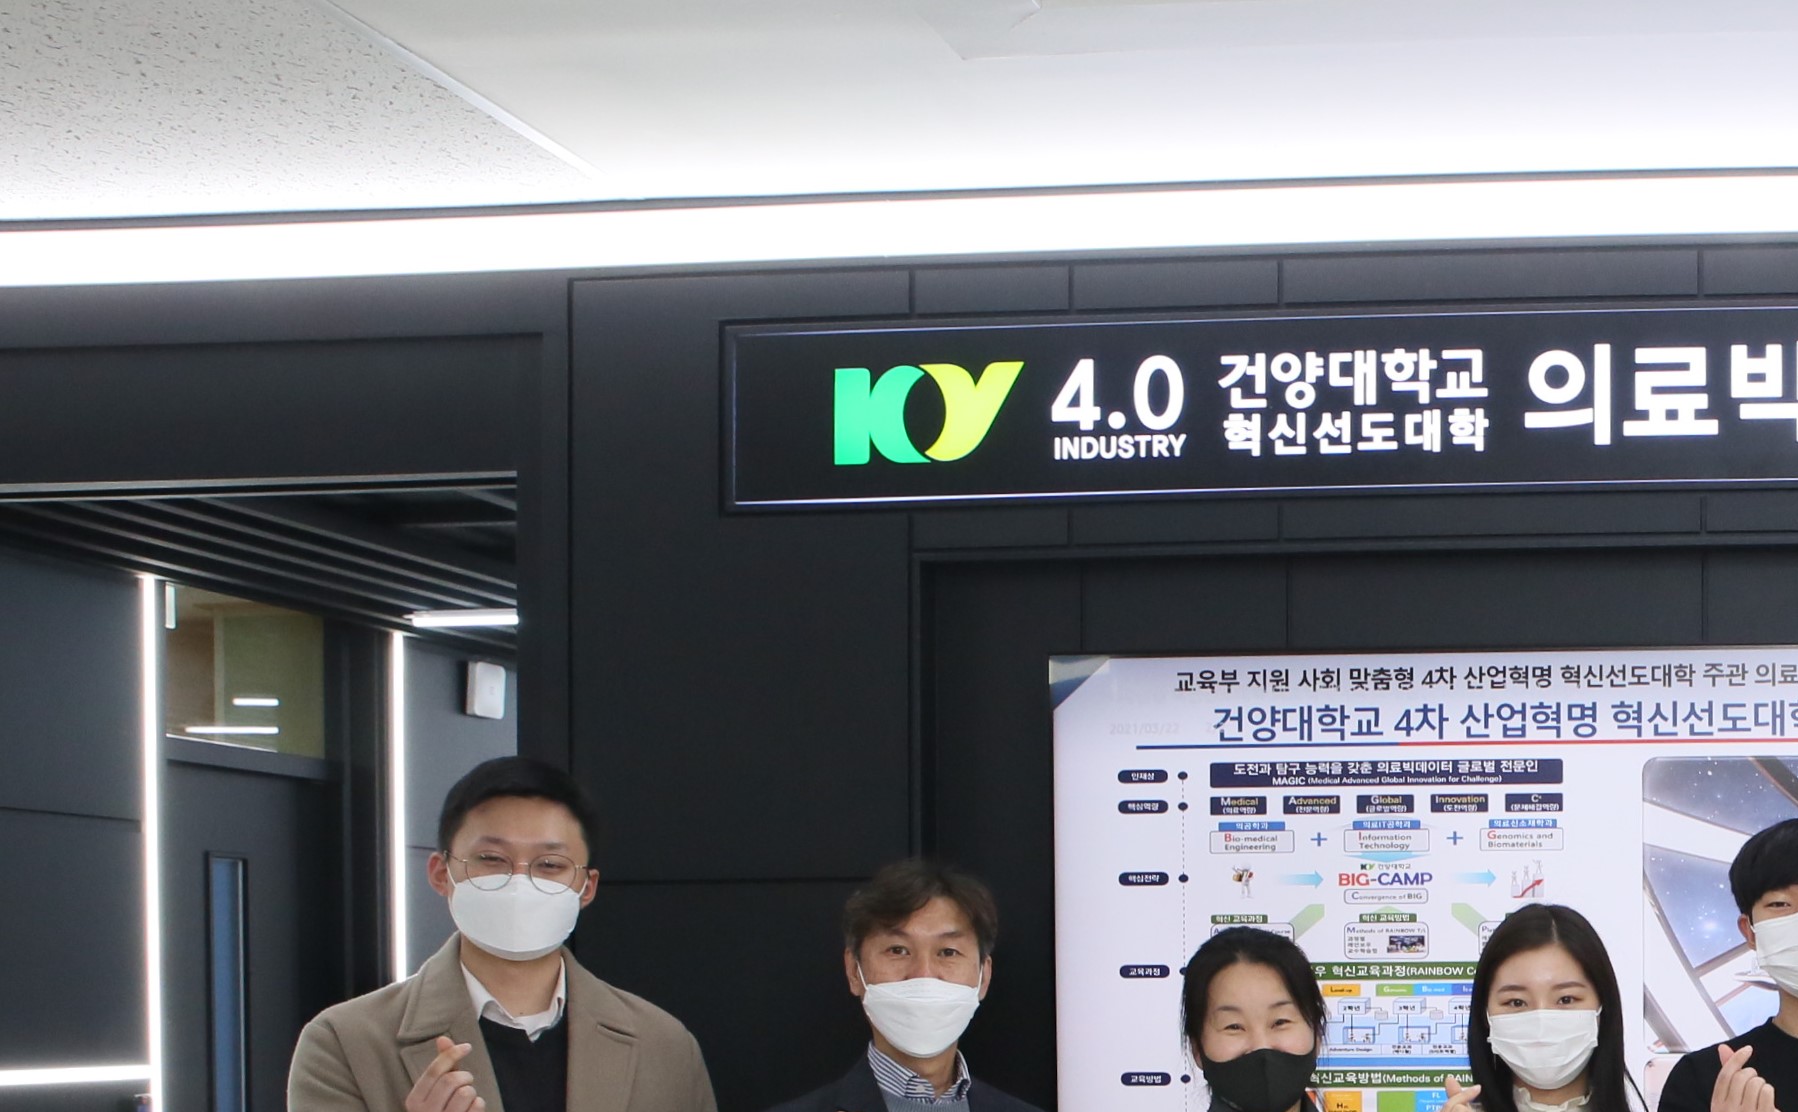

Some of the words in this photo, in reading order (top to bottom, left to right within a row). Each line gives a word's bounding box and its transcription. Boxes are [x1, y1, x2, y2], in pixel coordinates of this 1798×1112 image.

[1217, 346, 1489, 410] 건양대학교
[1050, 355, 1185, 431] 4.0
[1222, 408, 1490, 455] 혁신선도대학
[1053, 432, 1187, 461] INDUSTRY
[1173, 669, 1240, 693] 교육부
[1247, 668, 1290, 693] 지원
[1297, 667, 1341, 693] 사회
[1349, 666, 1415, 691] 맞춤형
[1421, 665, 1457, 690] 4차
[1463, 664, 1552, 690] 산업혁명
[1560, 663, 1696, 688] 혁신선도대학
[1702, 662, 1749, 687] 주관
[1212, 703, 1384, 742] 건양대학교
[1393, 702, 1449, 740] 4차
[1459, 701, 1598, 739] 산업혁명
[1233, 762, 1272, 776] 도전과
[1276, 762, 1301, 775] 탐구
[1305, 762, 1343, 775] 능력을
[1347, 761, 1373, 775] 갖춘
[1377, 760, 1453, 774] 의료빅데이터
[1457, 760, 1496, 773] 글로벌
[1500, 760, 1538, 773] 전문인
[1272, 776, 1306, 786] MAGIC
[1307, 776, 1340, 786] (Medical
[1341, 776, 1380, 785] Advanced
[1381, 775, 1405, 784] Global
[1407, 775, 1447, 783] Innovation
[1448, 775, 1460, 783] for
[1220, 797, 1259, 806] Medical
[1288, 796, 1337, 805] Advanced
[1370, 794, 1403, 804] Global
[1435, 795, 1486, 804] Innovation
[1224, 832, 1278, 842] Bio-medical
[1358, 831, 1412, 841] Information
[1486, 830, 1534, 840] Genomics
[1536, 832, 1554, 840] and
[1225, 843, 1277, 852] Engineering
[1359, 842, 1410, 851] Technology
[1487, 840, 1543, 848] Biomaterials
[1338, 872, 1433, 886] BIG-CAMP
[1407, 892, 1423, 900] BIG
[1433, 1073, 1445, 1083] of
